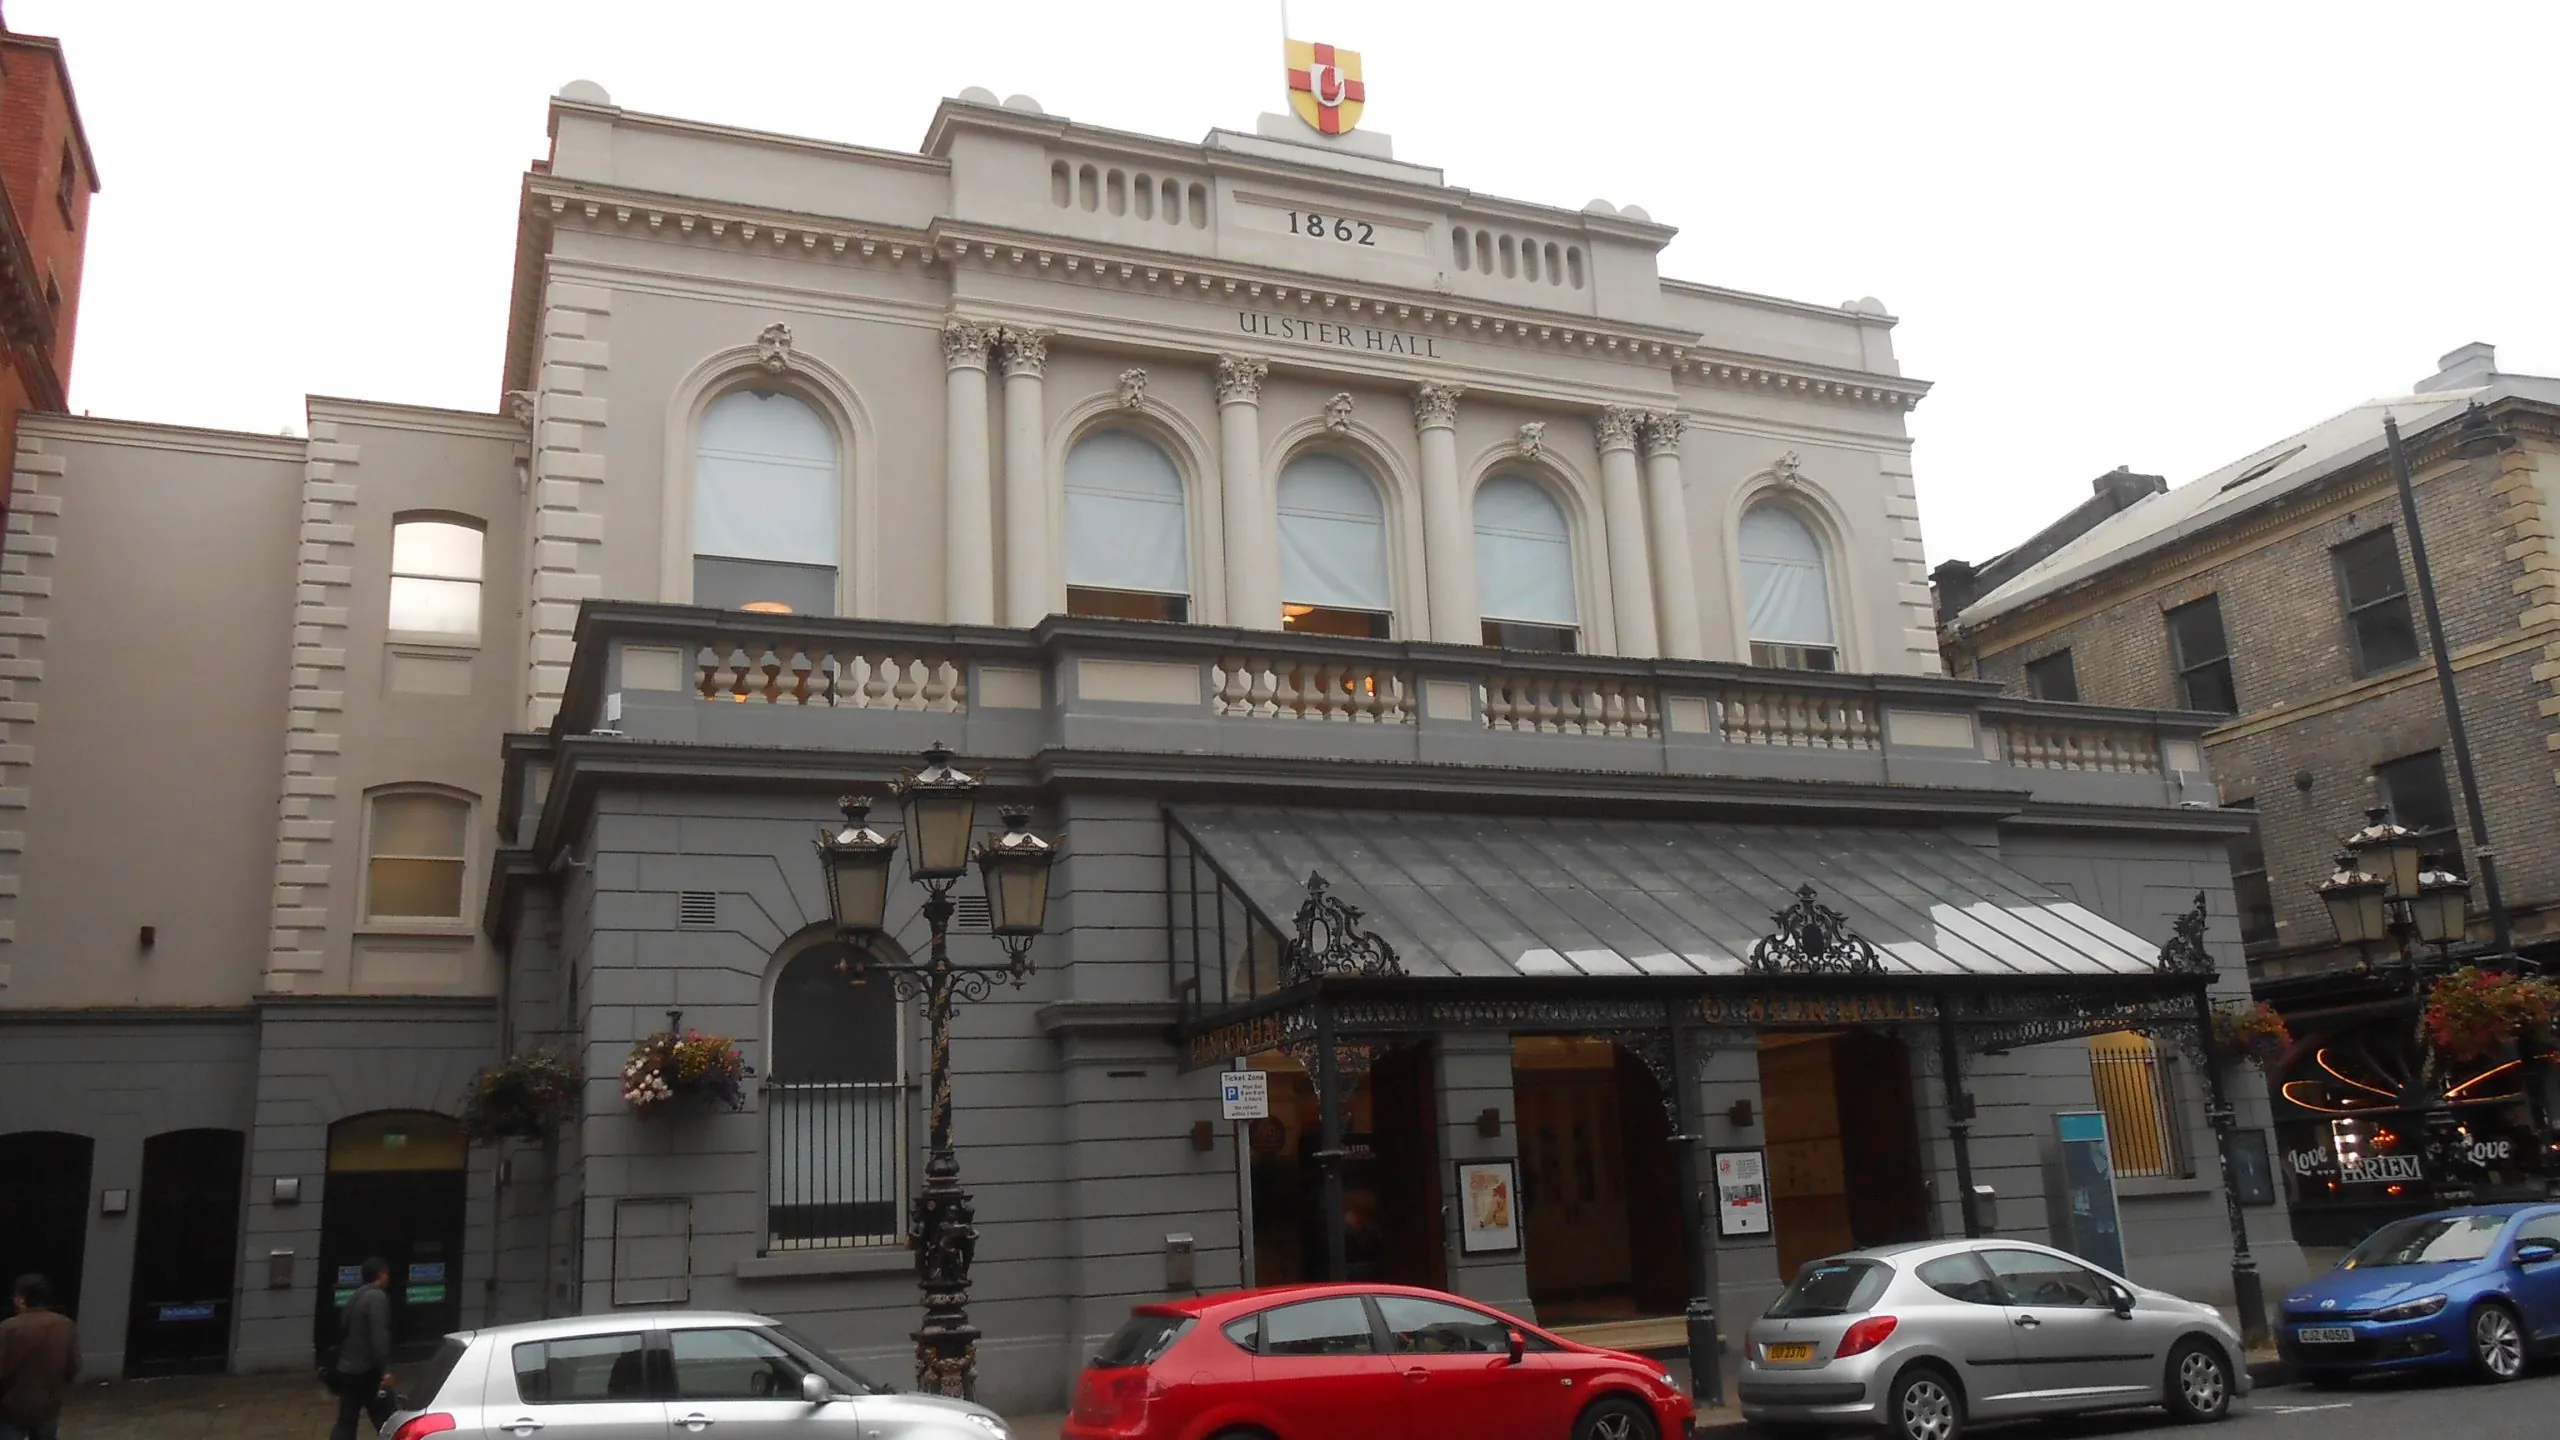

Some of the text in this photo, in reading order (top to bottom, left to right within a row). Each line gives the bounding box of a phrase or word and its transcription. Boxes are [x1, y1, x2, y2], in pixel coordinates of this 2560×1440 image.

[1288, 211, 1376, 246] 1862
[1239, 312, 1441, 359] ULSTER HALL
[1247, 1073, 1264, 1081] Zone
[1228, 1088, 1236, 1099] P
[2288, 1146, 2329, 1176] Love
[2465, 1141, 2510, 1167] Love
[2340, 1156, 2423, 1182] HARLEM
[1785, 1346, 1807, 1359] 2370
